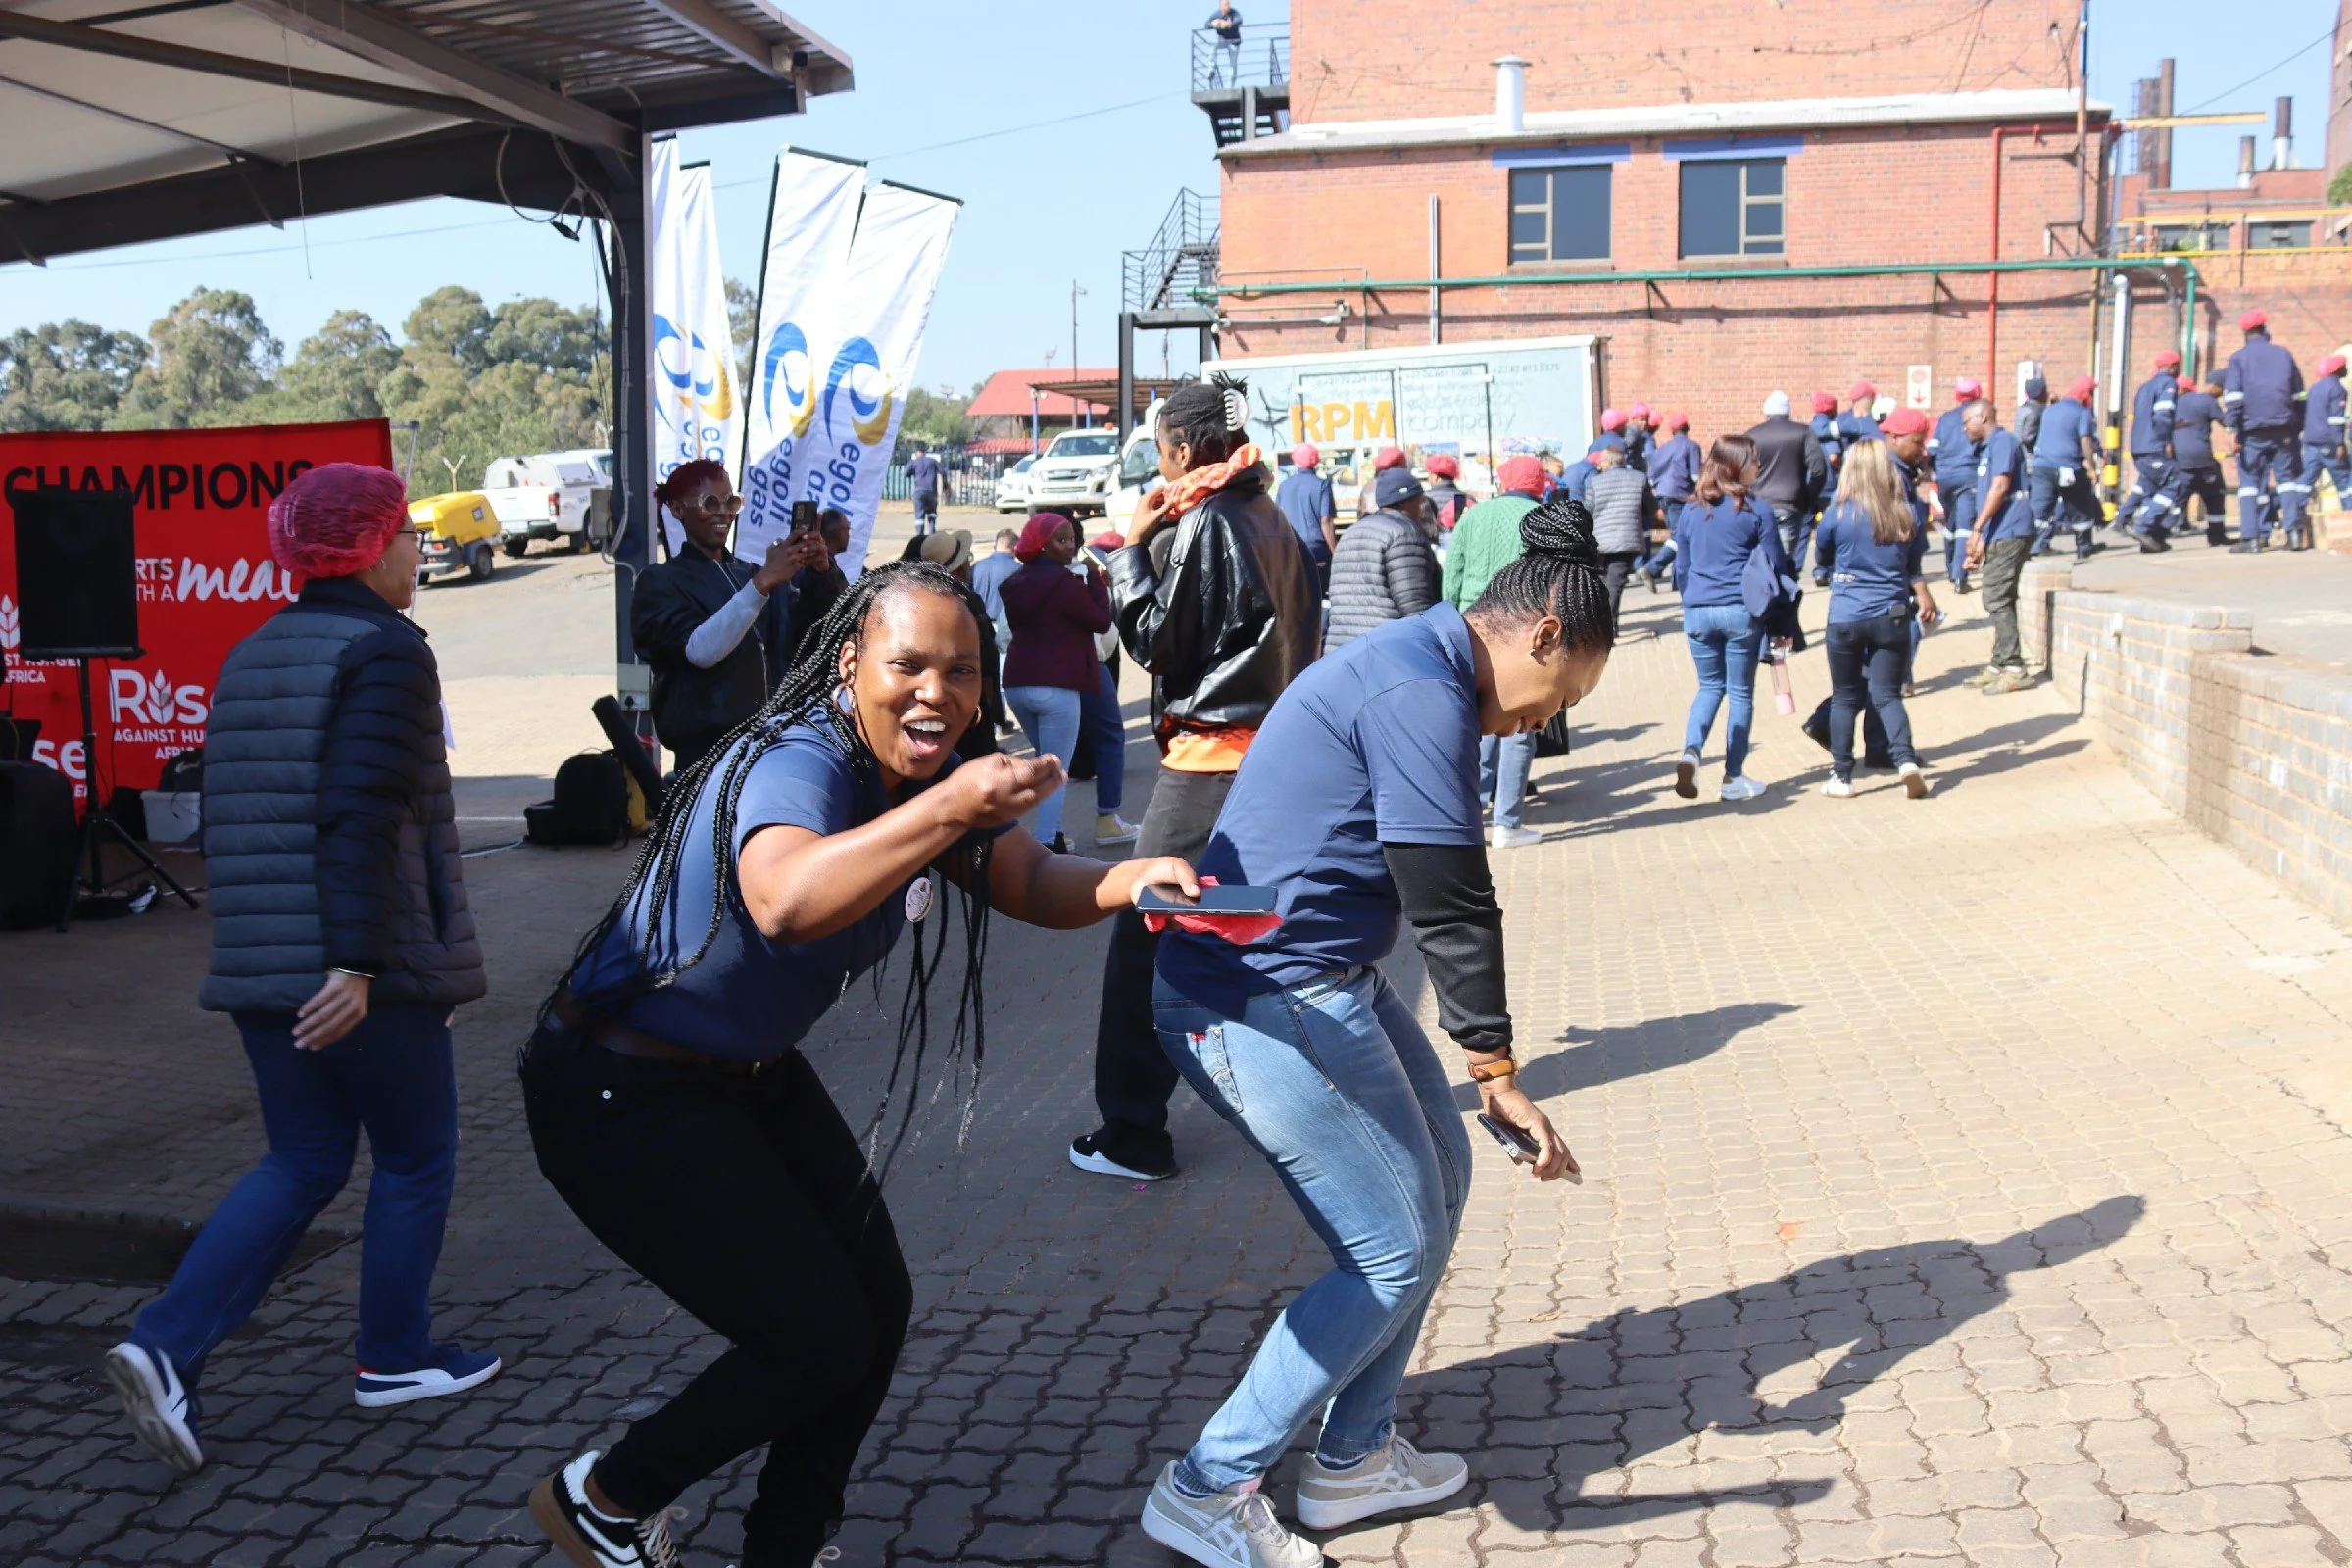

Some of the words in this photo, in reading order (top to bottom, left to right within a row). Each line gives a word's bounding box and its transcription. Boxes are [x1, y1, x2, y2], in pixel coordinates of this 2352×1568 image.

[1290, 400, 1396, 443] RPM
[1409, 411, 1517, 436] company
[748, 466, 768, 528] gas
[769, 438, 792, 526] egoli
[827, 443, 860, 517] egol
[161, 583, 174, 601] A
[114, 729, 175, 742] AGAINST
